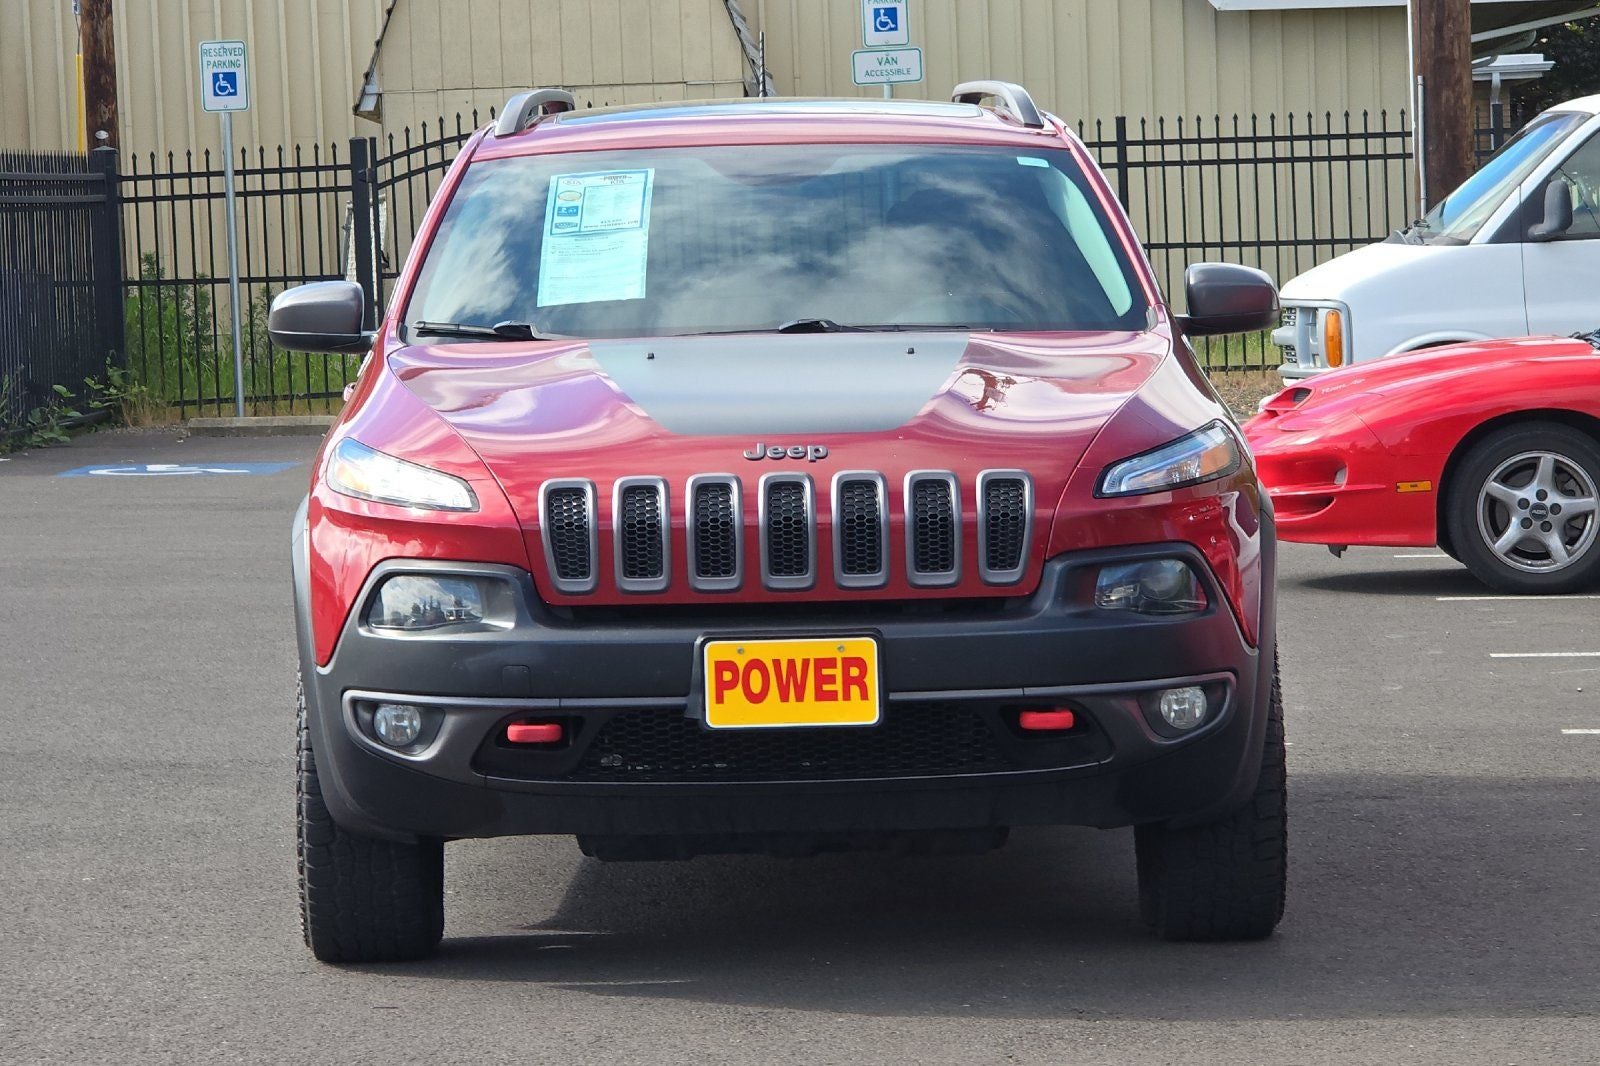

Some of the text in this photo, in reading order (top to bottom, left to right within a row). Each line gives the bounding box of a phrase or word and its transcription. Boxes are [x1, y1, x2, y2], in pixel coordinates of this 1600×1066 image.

[203, 47, 243, 57] RESERVED
[206, 59, 241, 69] PARKING
[876, 56, 898, 66] VAN
[864, 67, 911, 77] ACCESSIBLE
[743, 443, 828, 462] Jeep
[714, 656, 869, 705] POWER
